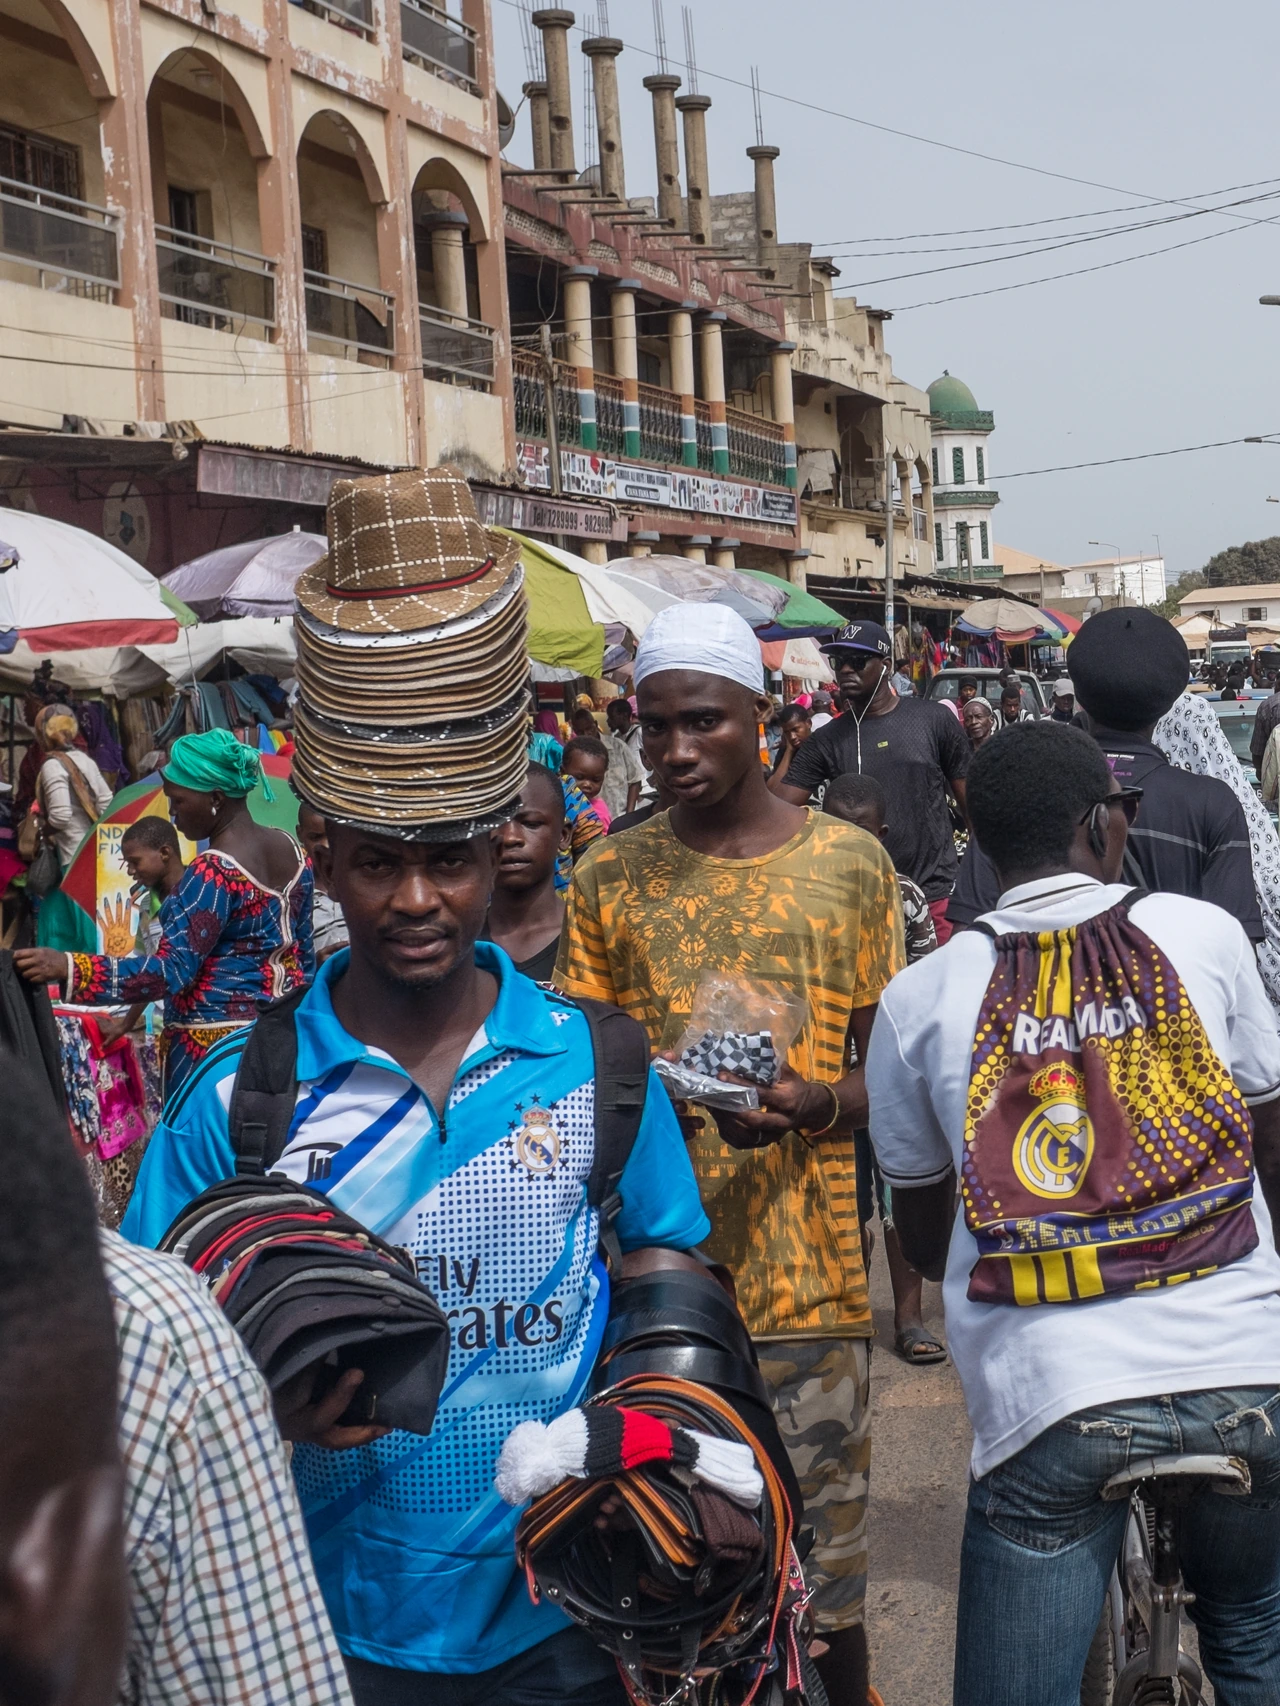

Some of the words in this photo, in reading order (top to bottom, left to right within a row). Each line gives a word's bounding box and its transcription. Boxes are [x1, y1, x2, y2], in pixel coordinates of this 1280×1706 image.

[533, 506, 546, 528] Tel:
[547, 509, 578, 530] 7289999
[877, 640, 890, 654] UW
[1015, 1219, 1101, 1250] REAL
[1200, 1224, 1216, 1235] Club
[415, 1254, 480, 1297] Fly
